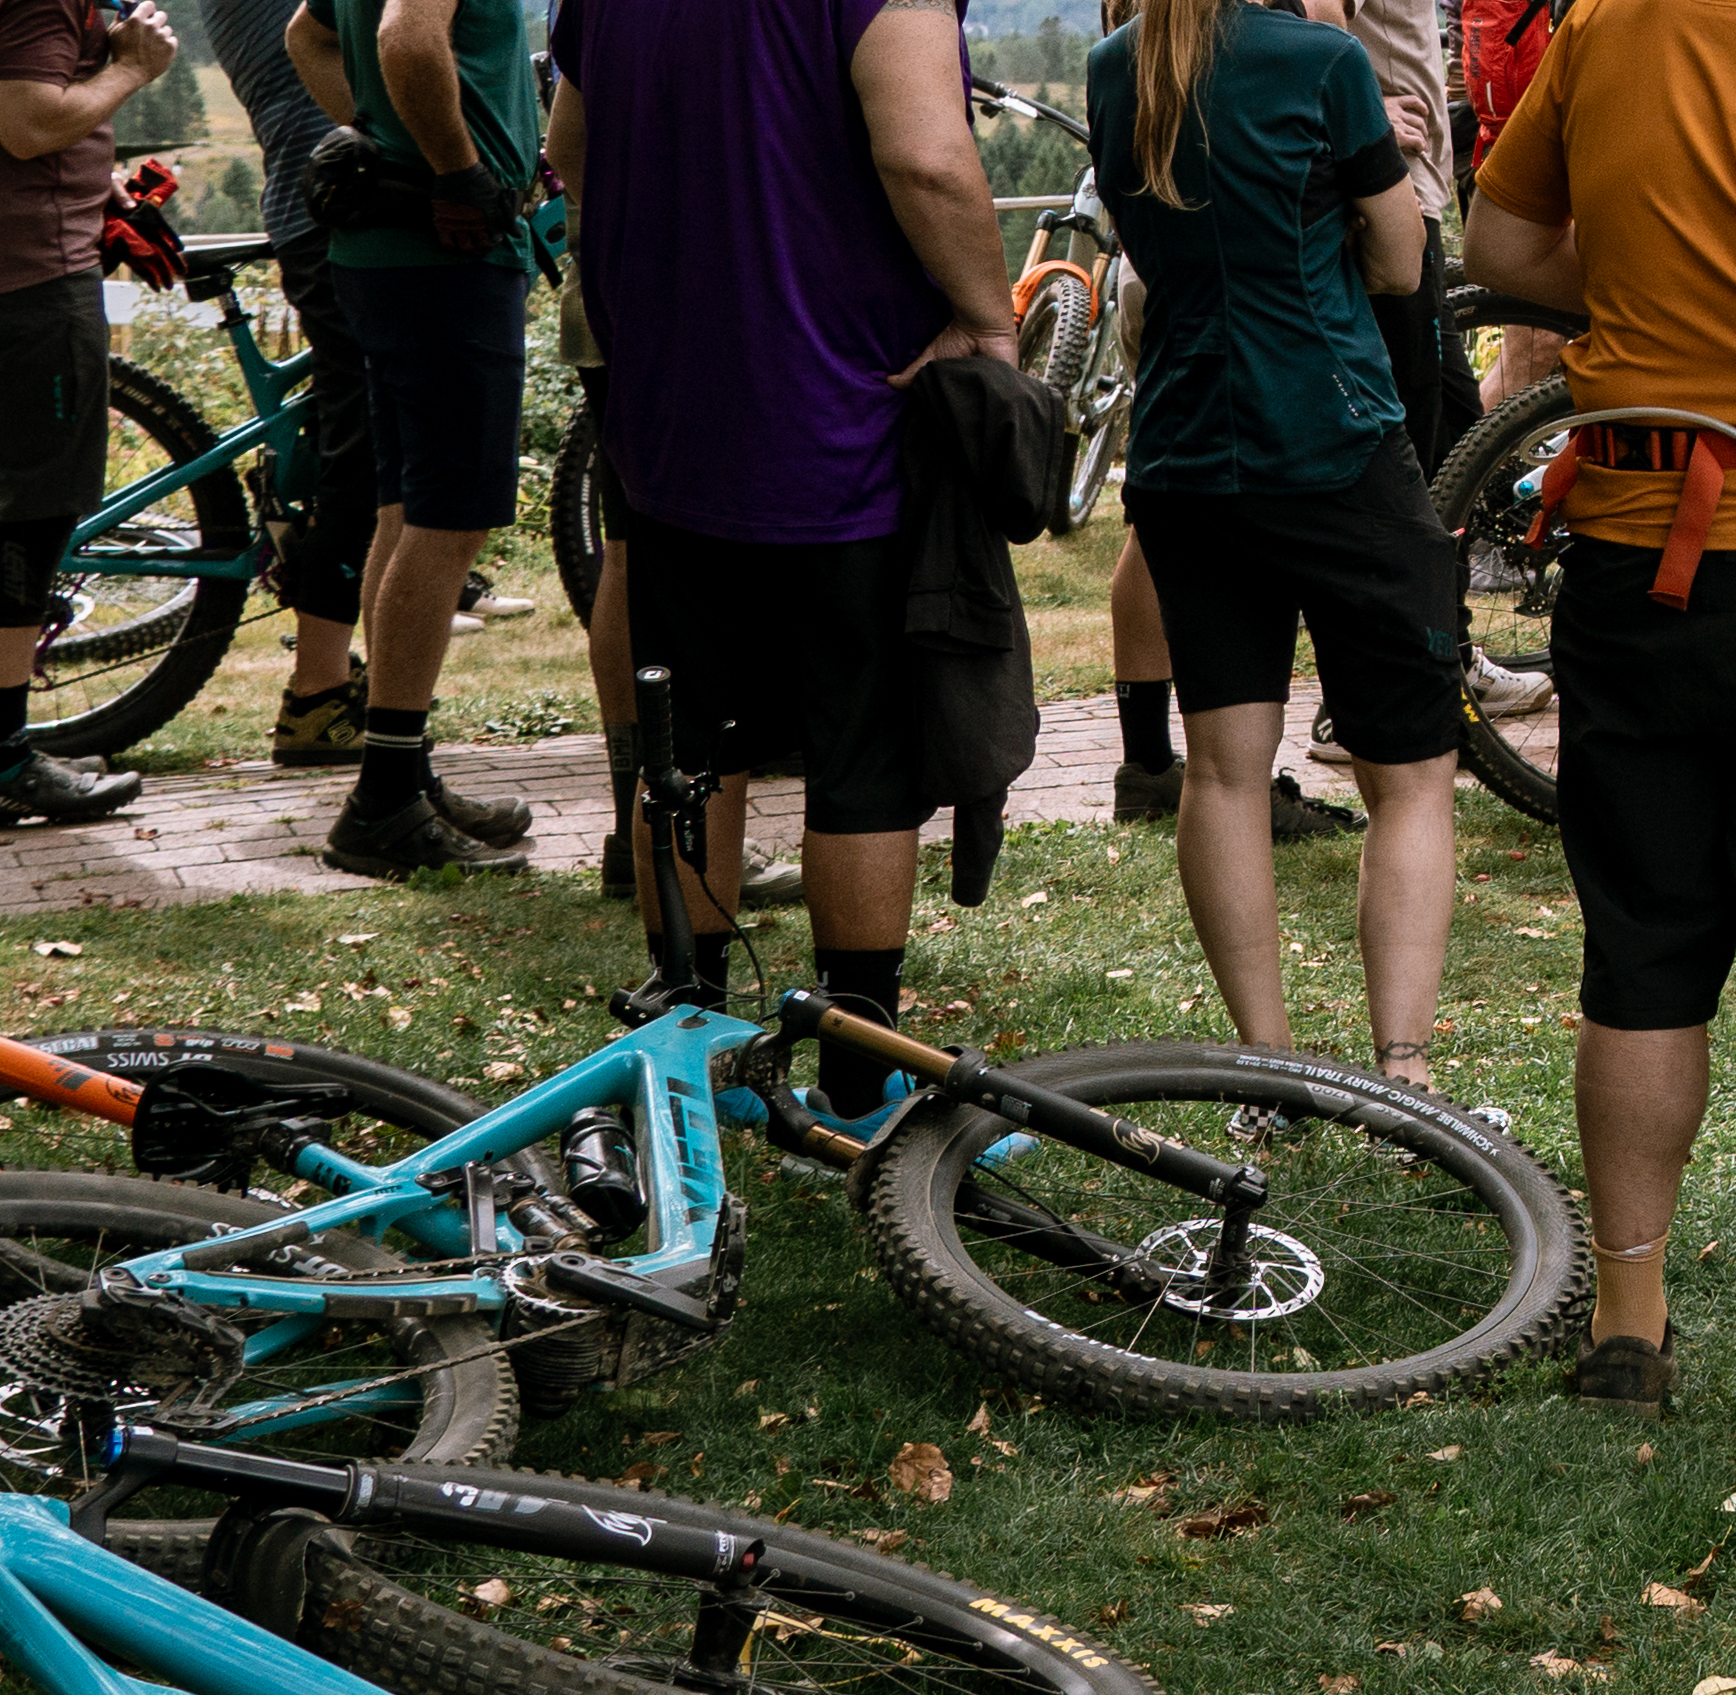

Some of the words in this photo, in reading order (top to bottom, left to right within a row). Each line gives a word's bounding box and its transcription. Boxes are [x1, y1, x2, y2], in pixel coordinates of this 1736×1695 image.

[106, 1051, 171, 1068] SWISS
[1303, 1064, 1348, 1086] TRAIL
[1346, 1076, 1391, 1096] MARY
[1312, 1085, 1347, 1101] 1700
[1387, 1089, 1437, 1117] MAGIC
[1435, 1112, 1495, 1154] SCHWALBE
[968, 1597, 1110, 1669] MAXXIS
